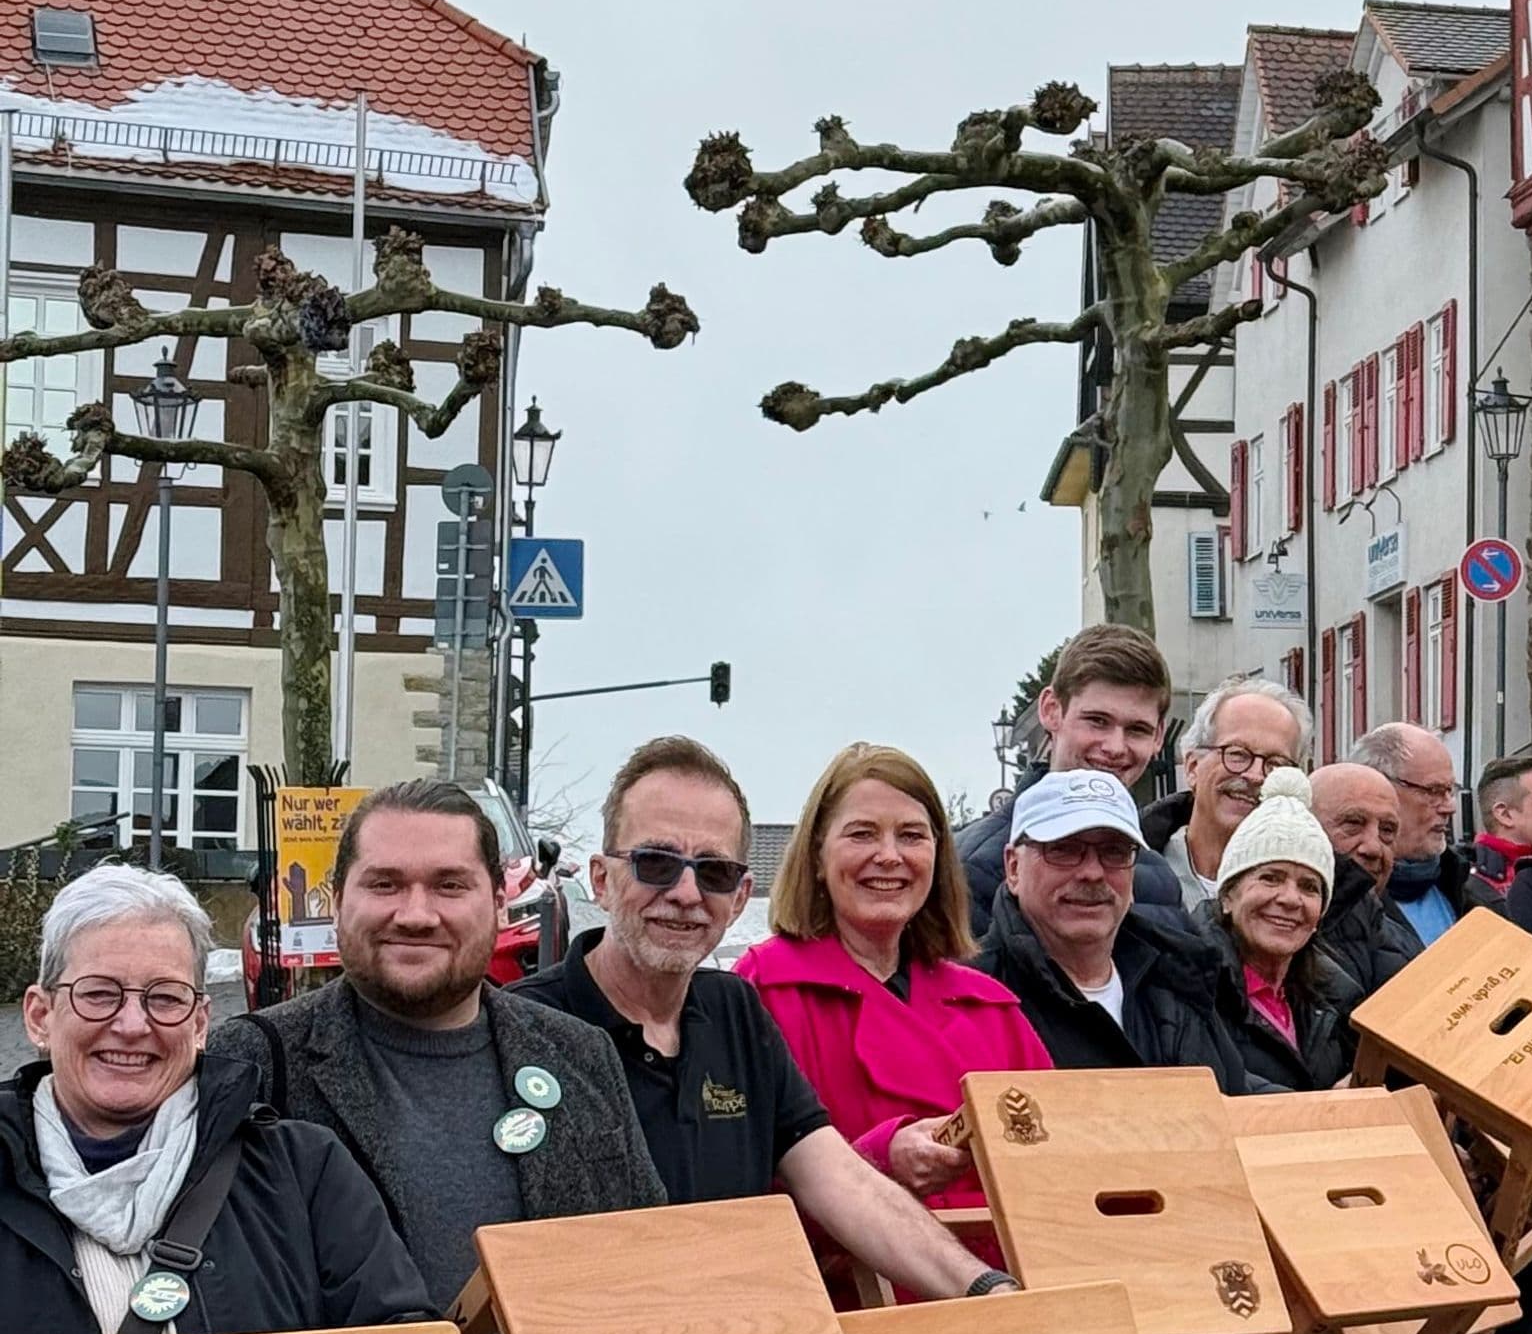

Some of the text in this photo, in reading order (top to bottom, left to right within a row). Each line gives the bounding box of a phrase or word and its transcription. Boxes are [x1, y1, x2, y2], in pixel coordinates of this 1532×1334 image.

[282, 794, 341, 812] Nur wer
[282, 813, 328, 834] wählt,
